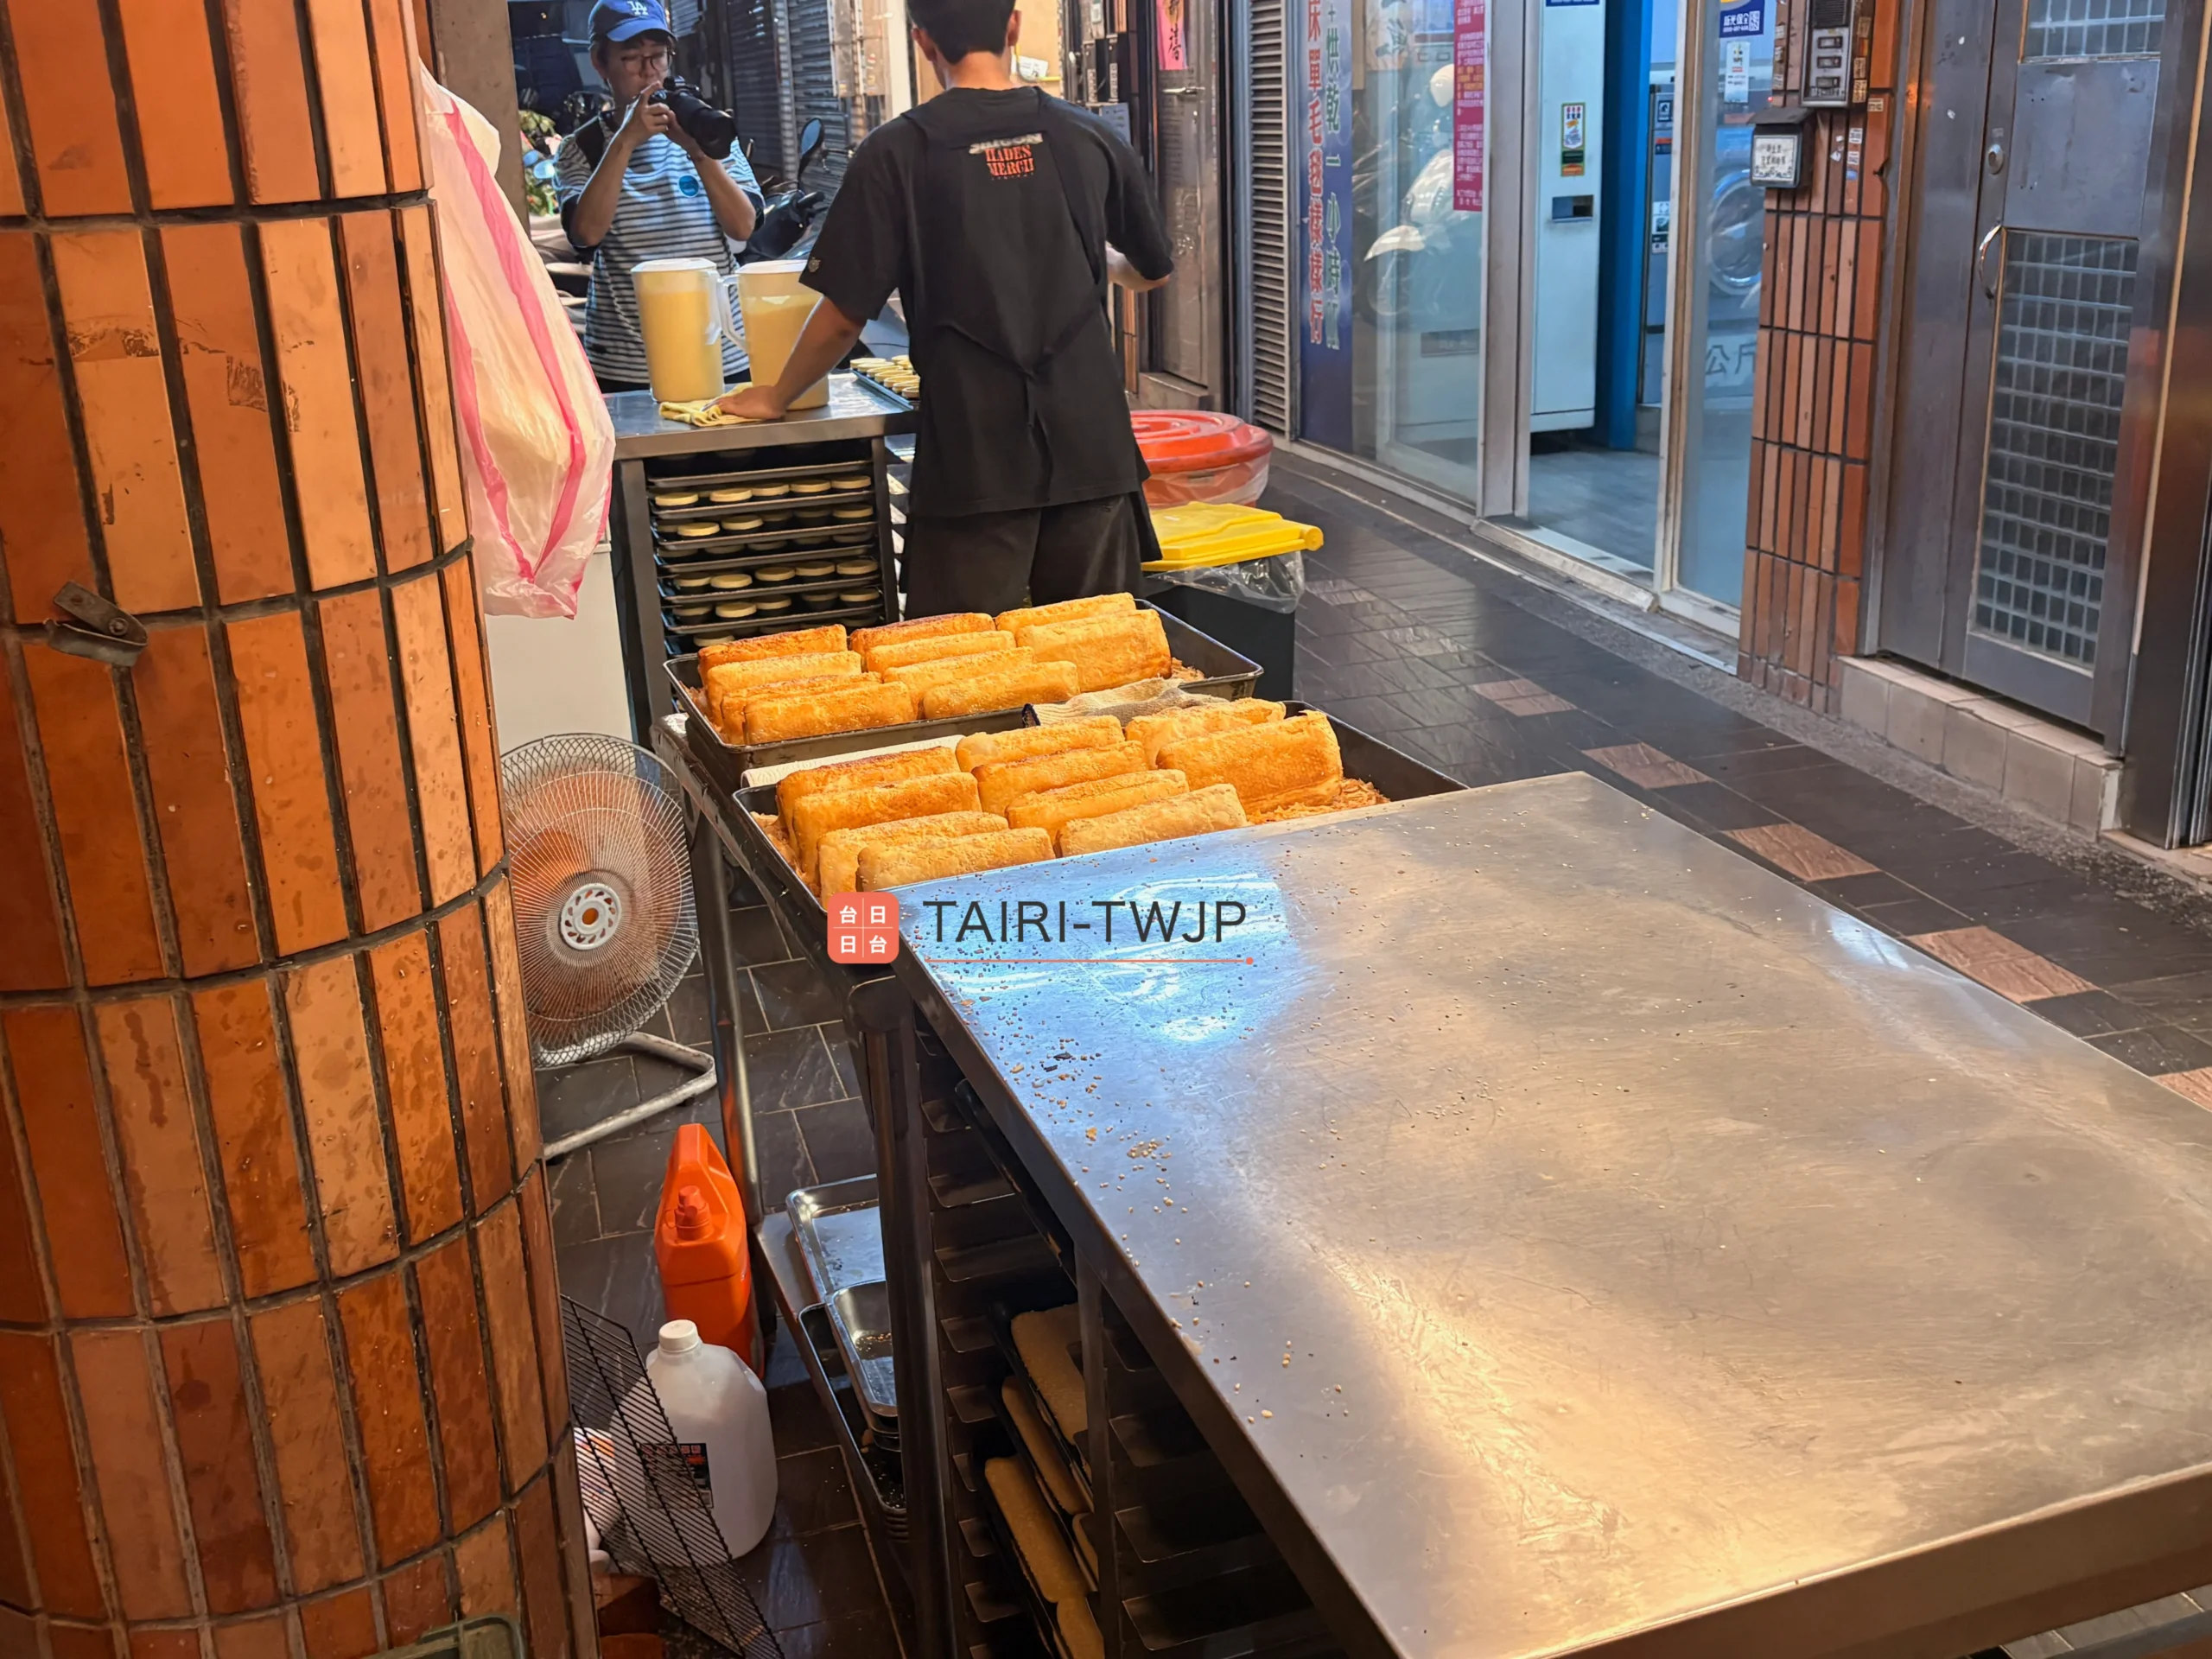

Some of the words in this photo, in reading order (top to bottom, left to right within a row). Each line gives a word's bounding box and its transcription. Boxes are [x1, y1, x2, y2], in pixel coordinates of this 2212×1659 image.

[626, 1, 649, 16] LA
[984, 144, 1032, 162] HADES
[987, 158, 1035, 176] MERCH
